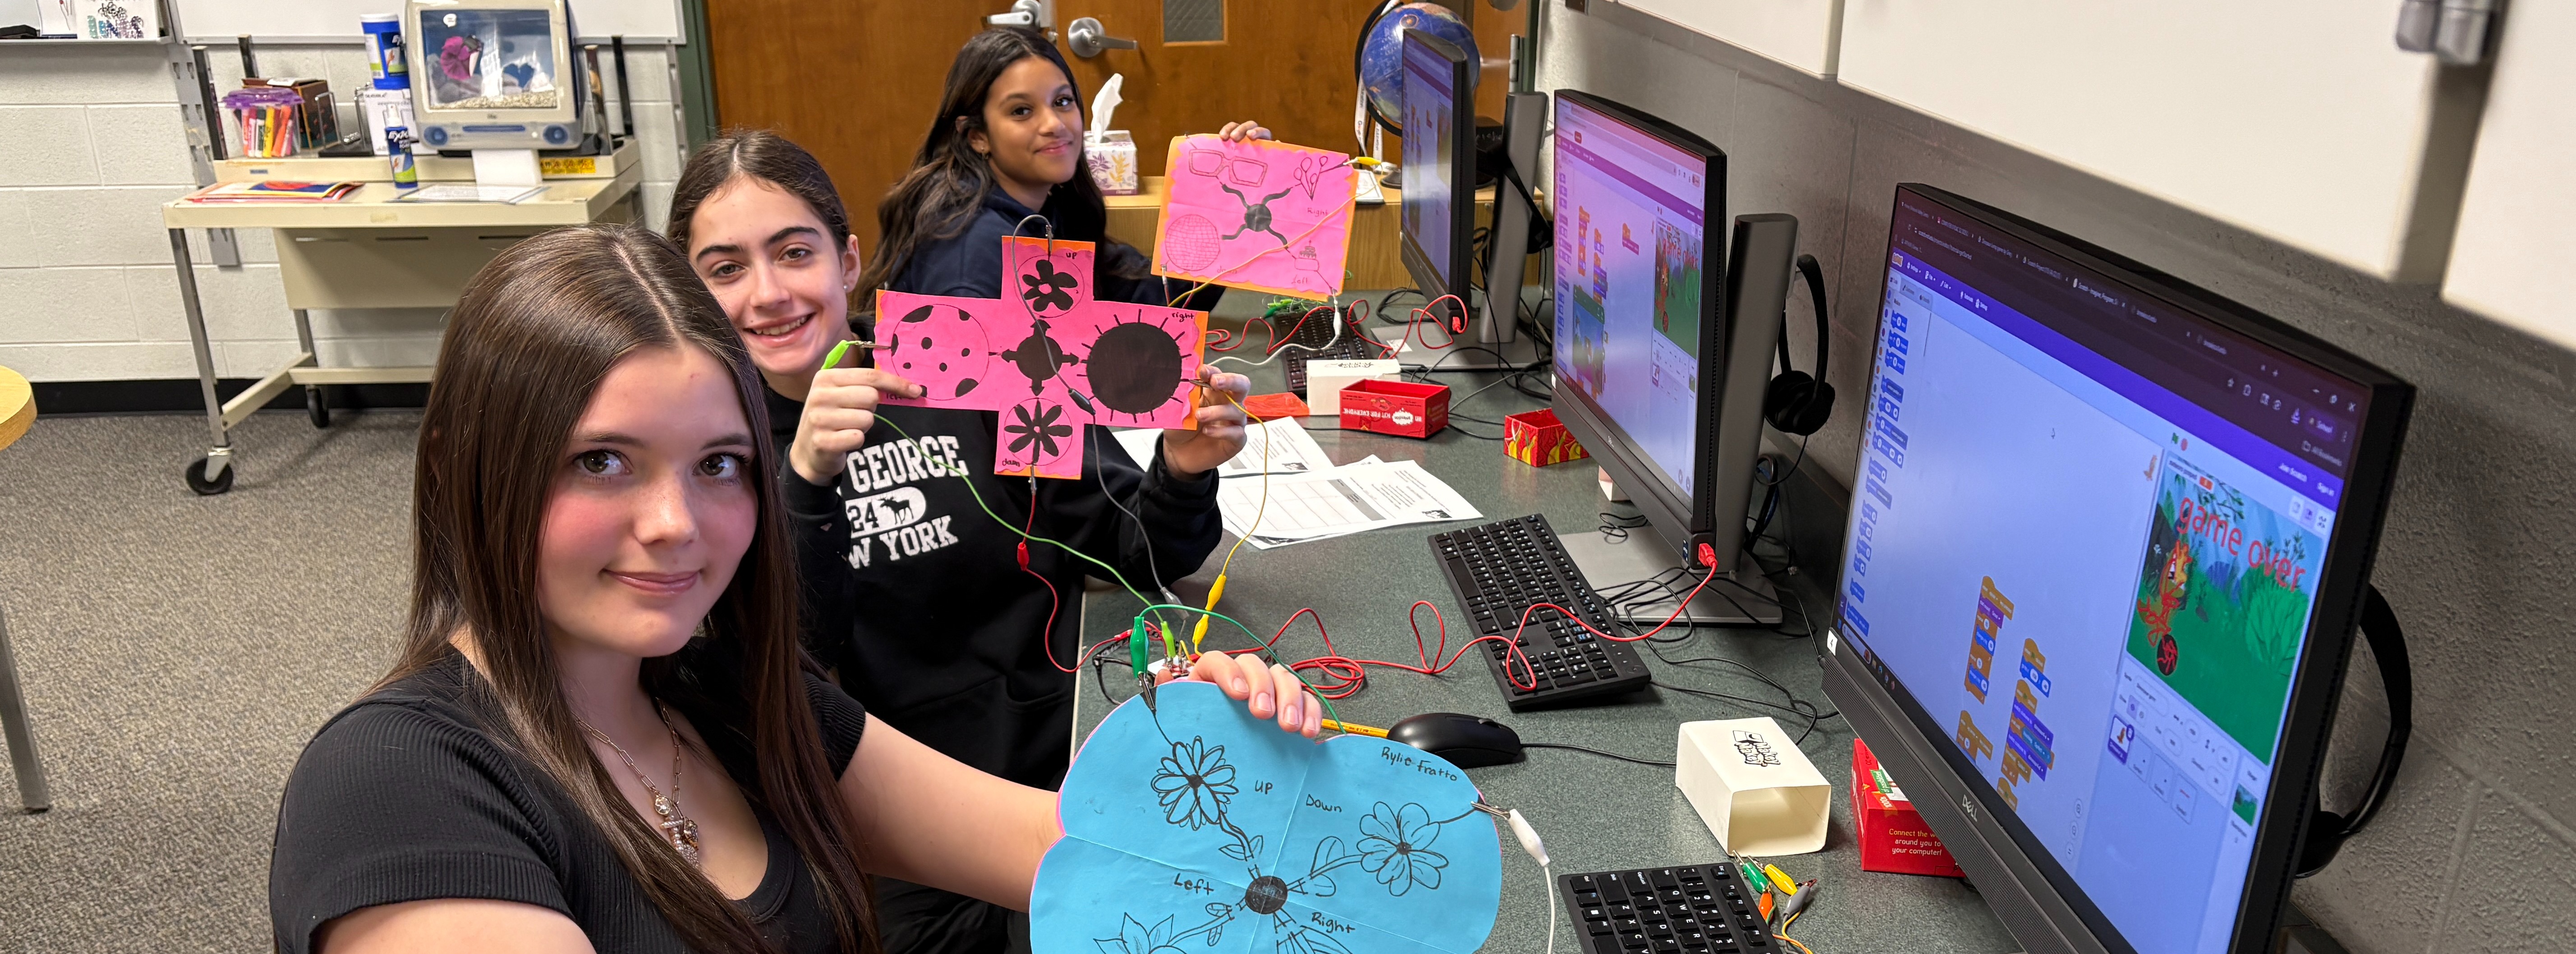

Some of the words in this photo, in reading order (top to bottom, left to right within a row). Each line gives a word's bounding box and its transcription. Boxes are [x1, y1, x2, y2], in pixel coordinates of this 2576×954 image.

[1172, 311, 1195, 323] right
[1343, 407, 1370, 417] EVERYONE
[846, 435, 969, 493] GEORGE
[879, 515, 959, 562] YORK
[2177, 497, 2243, 556] game
[2248, 540, 2306, 593] over
[1381, 746, 1412, 766] Rylie
[1417, 760, 1458, 781] Fratto
[1306, 793, 1343, 813] Down
[1962, 794, 1978, 822] DELL
[1889, 828, 1916, 837] Connect
[1174, 872, 1214, 895] Left
[1311, 912, 1356, 935] Right
